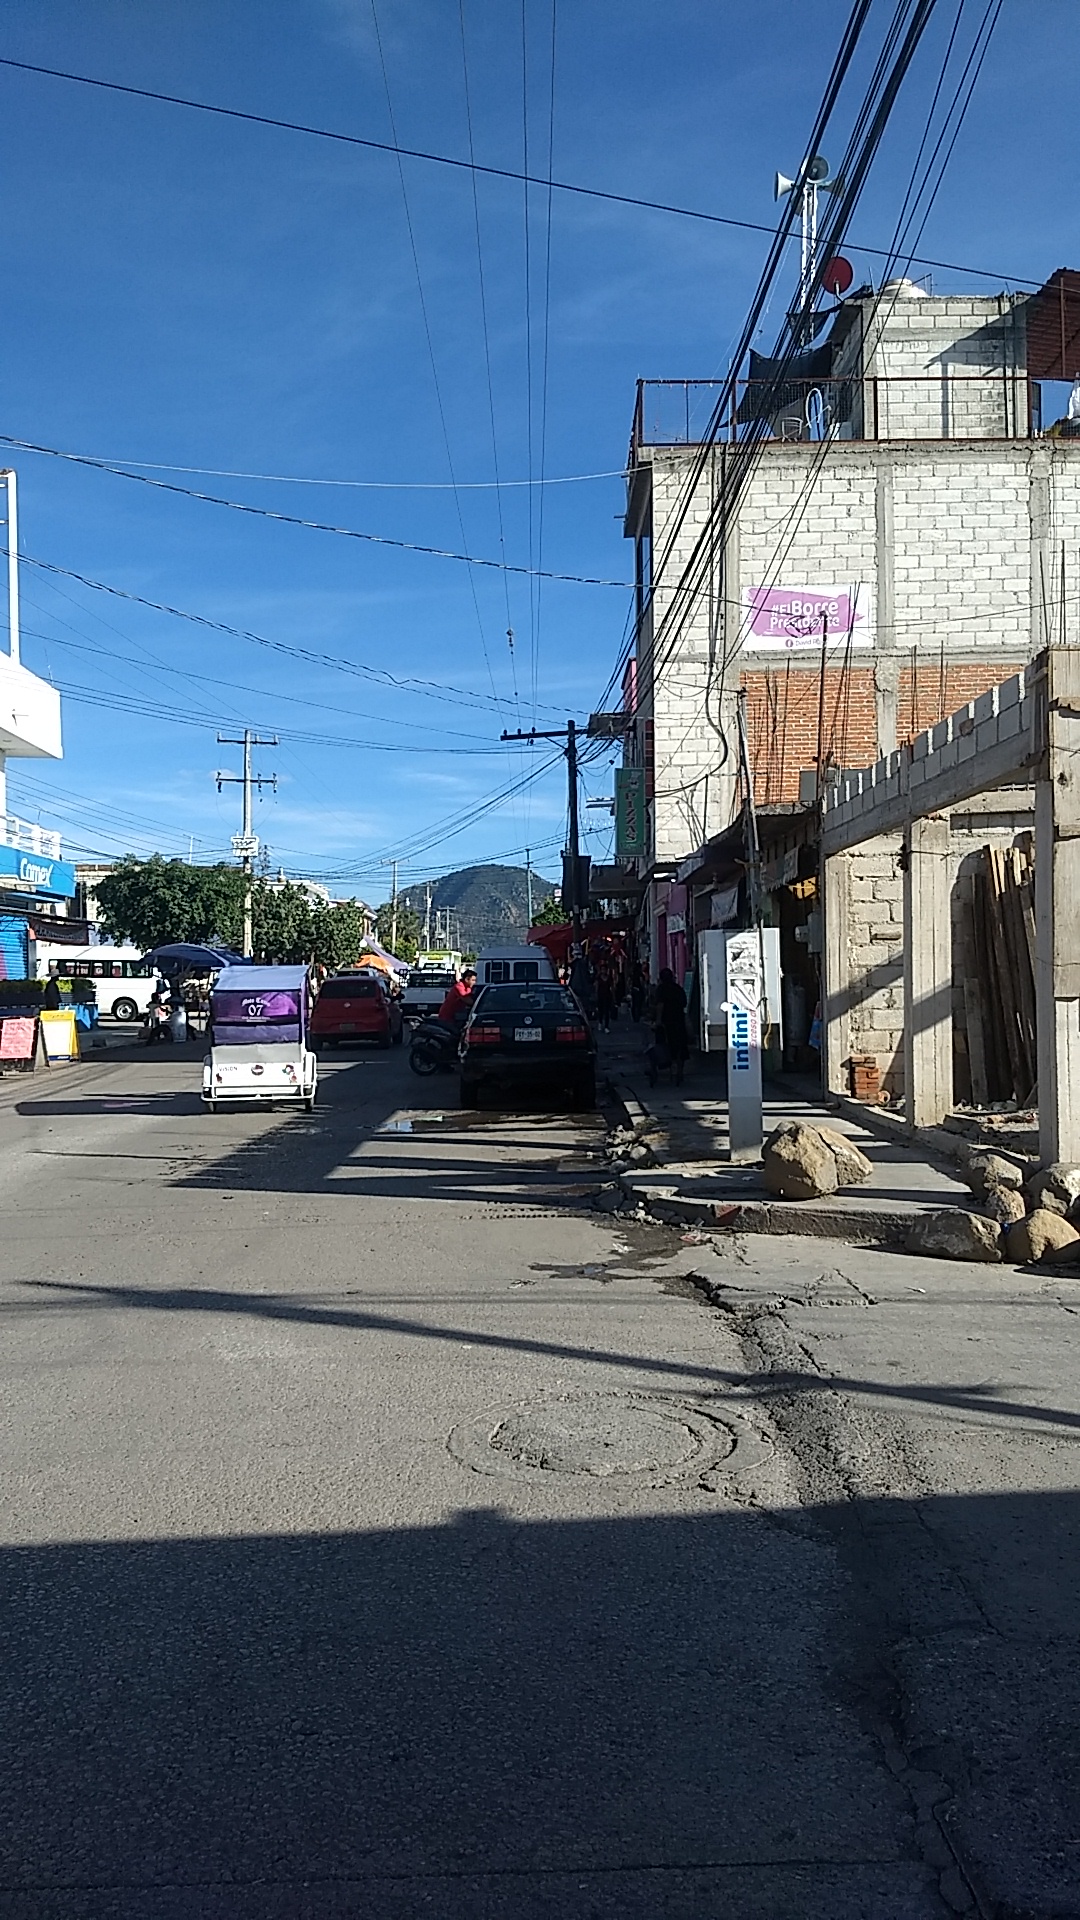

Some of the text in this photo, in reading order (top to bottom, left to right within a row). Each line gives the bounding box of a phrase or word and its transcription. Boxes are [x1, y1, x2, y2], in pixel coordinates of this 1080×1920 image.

[624, 792, 637, 843] PIZZAS
[20, 858, 54, 888] Comex
[248, 1004, 263, 1016] 07
